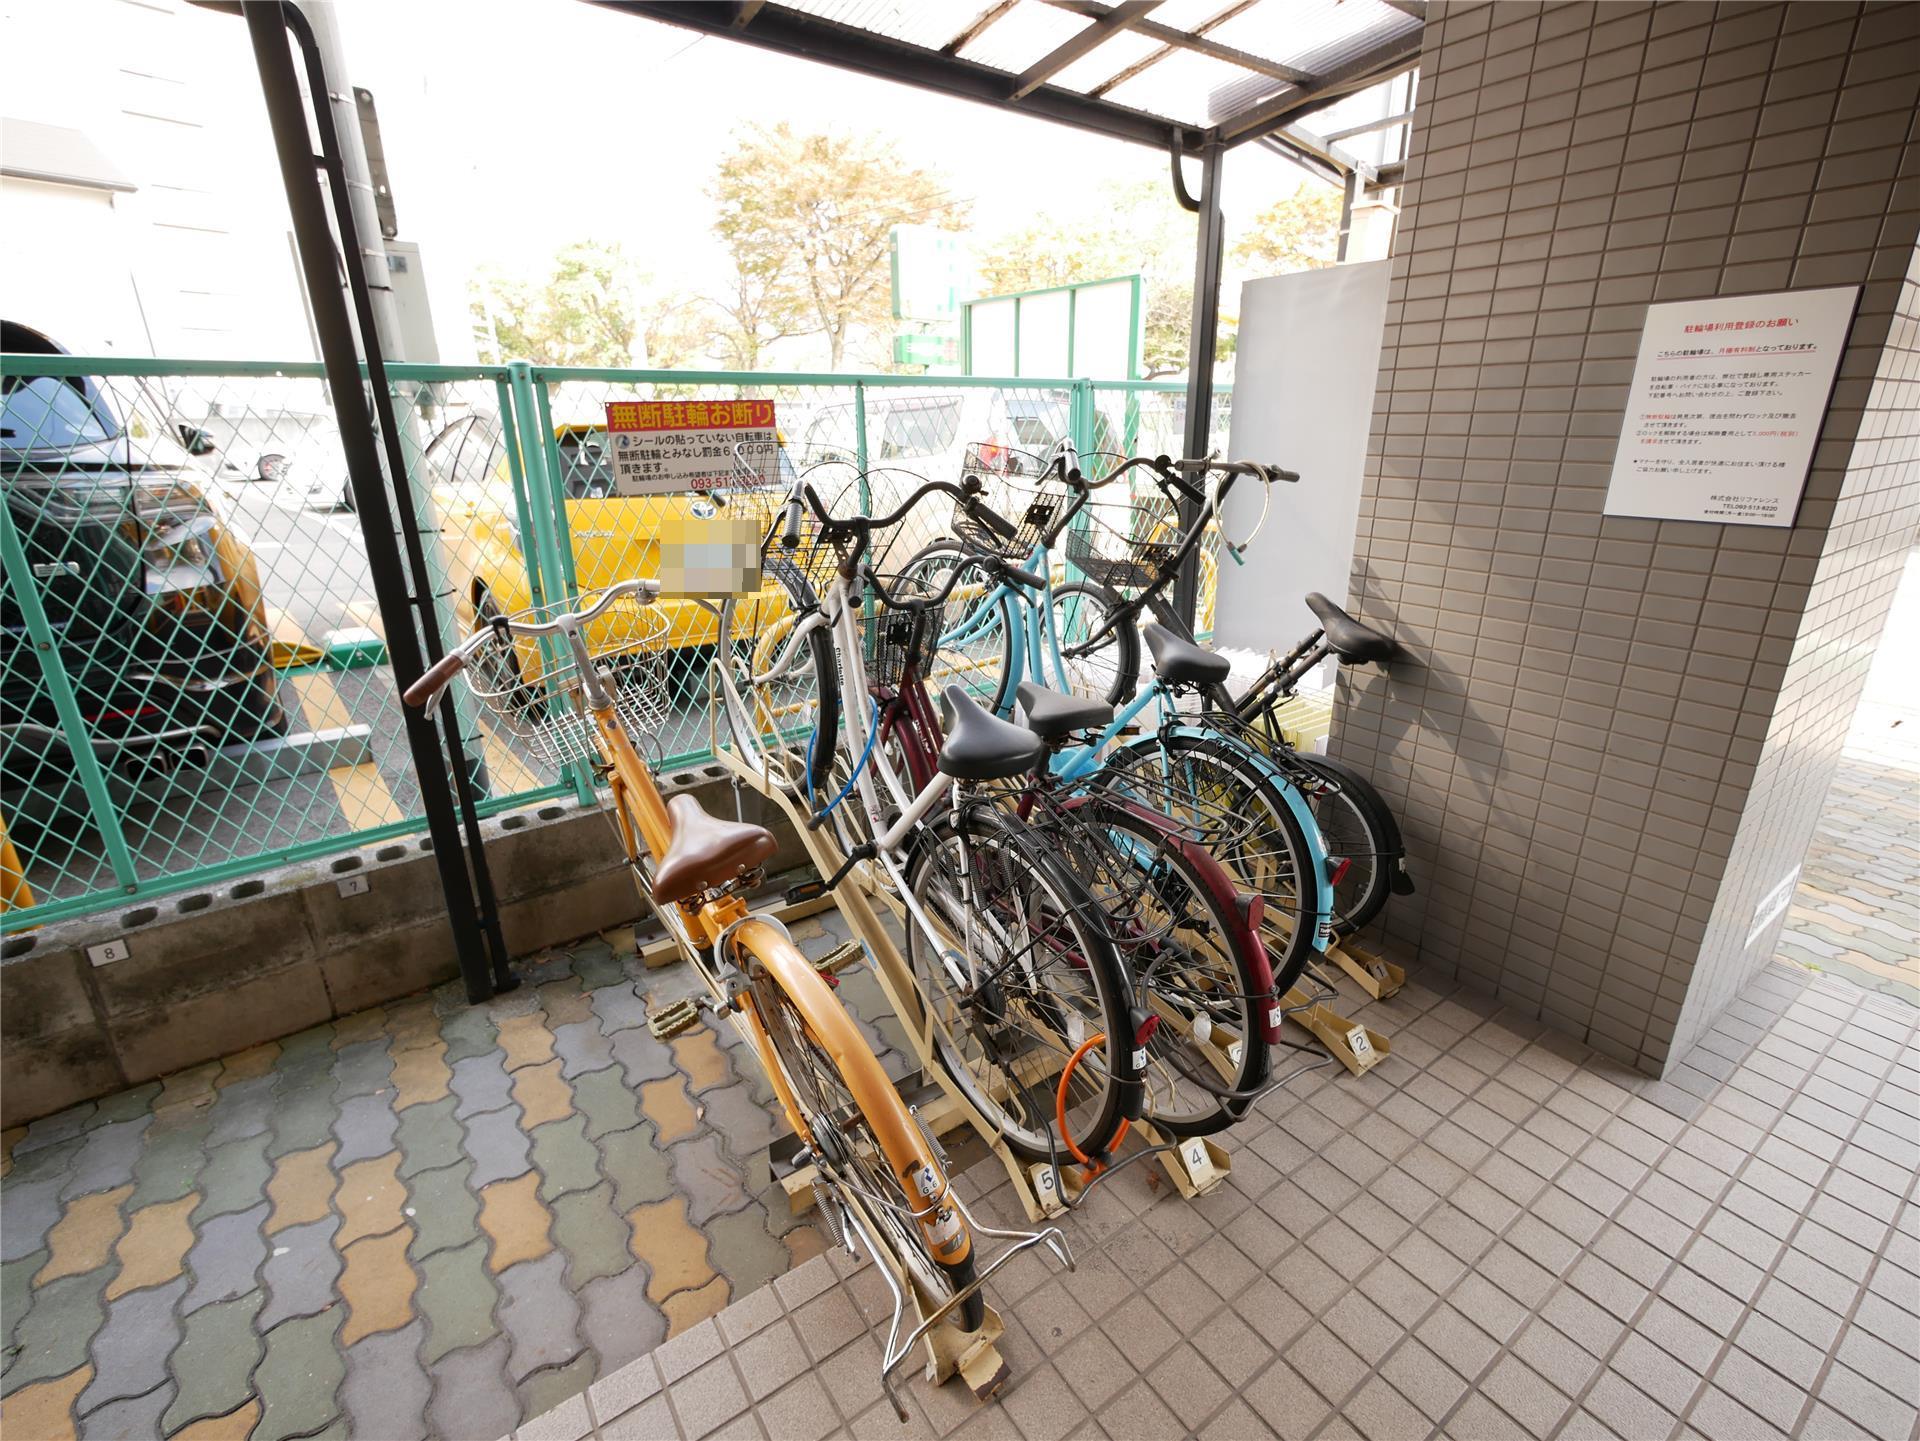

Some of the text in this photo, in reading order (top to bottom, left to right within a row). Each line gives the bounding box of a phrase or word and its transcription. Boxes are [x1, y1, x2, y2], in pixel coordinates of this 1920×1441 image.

[1684, 318, 1799, 333] 駐輪場利用登録のお願い
[612, 403, 772, 429] 無断駐輪お断り
[632, 432, 772, 447] シールの貼っていない自転車は
[620, 462, 668, 475] 頂きます。
[104, 947, 115, 959] 8
[1355, 1036, 1366, 1051] 2
[1192, 1148, 1202, 1164] 4
[1041, 1170, 1054, 1189] 5
